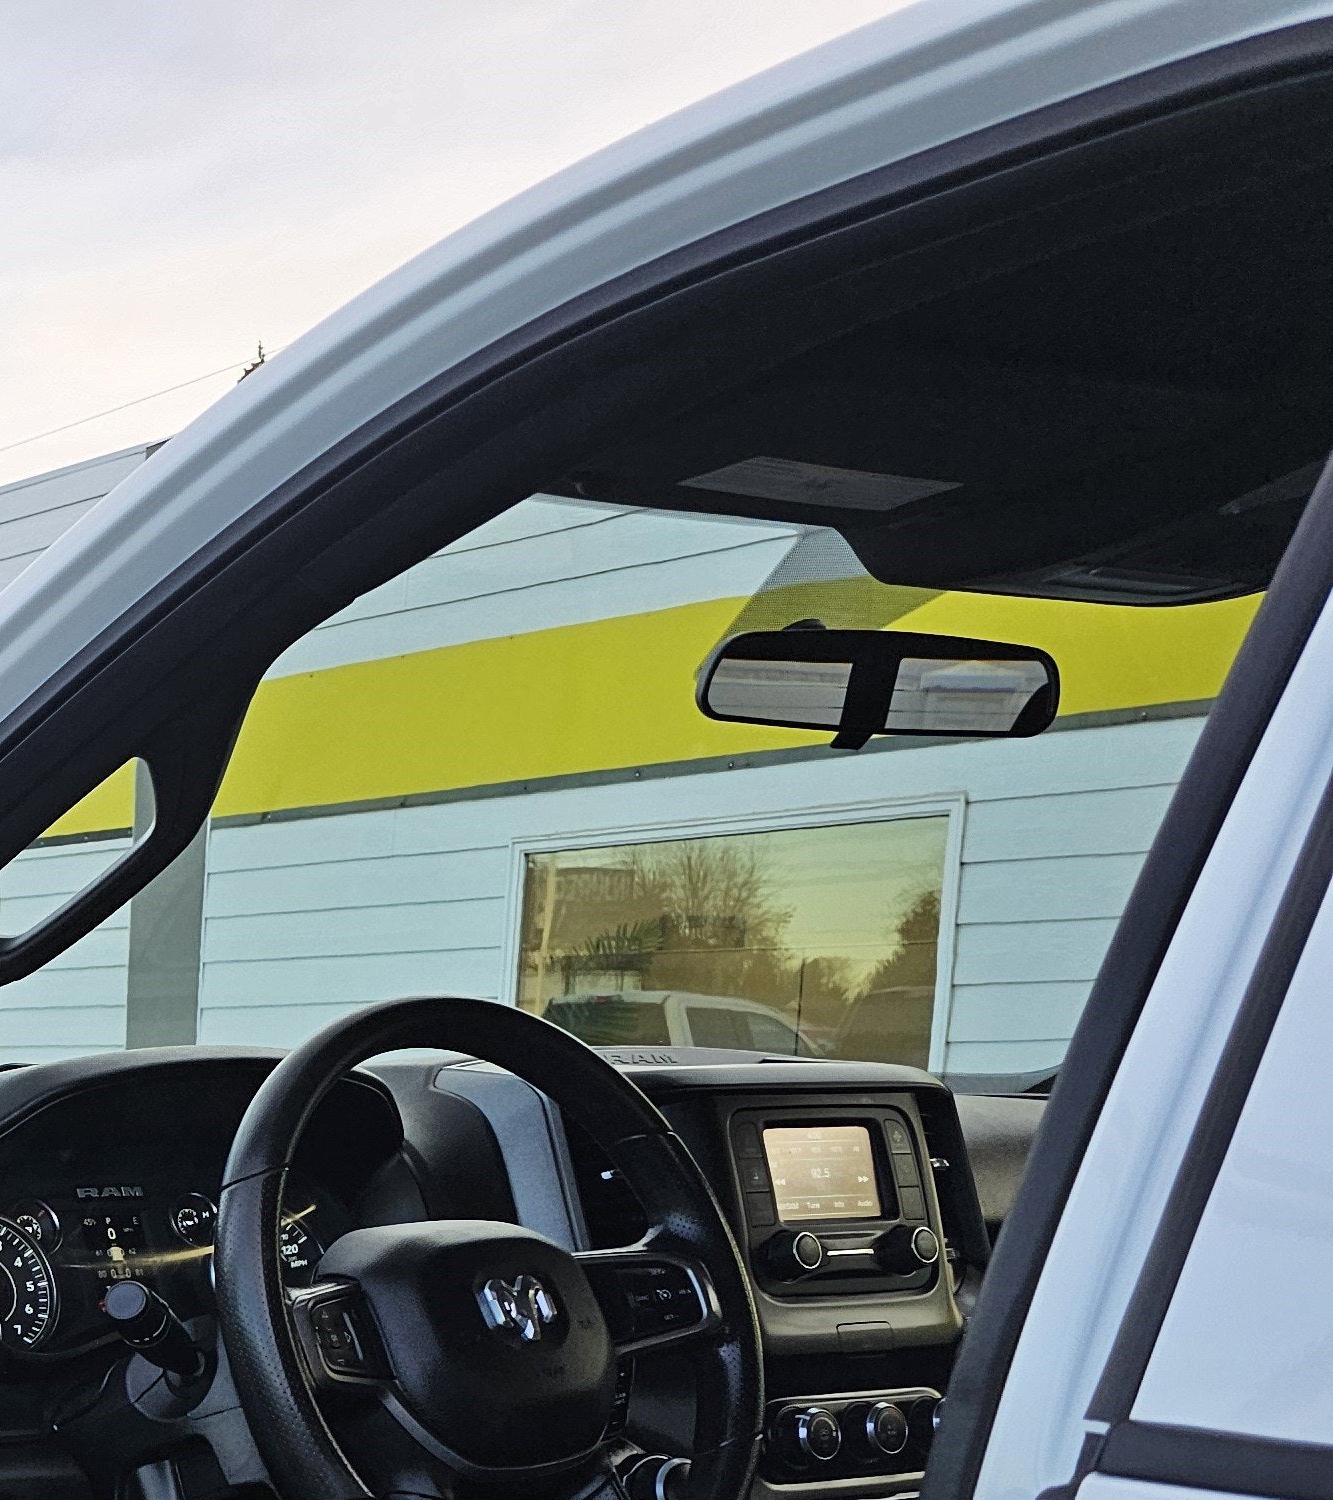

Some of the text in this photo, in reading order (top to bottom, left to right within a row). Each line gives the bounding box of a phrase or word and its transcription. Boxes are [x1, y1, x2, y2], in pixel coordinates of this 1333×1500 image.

[76, 1186, 144, 1198] RAM
[281, 1243, 299, 1255] 120
[13, 1256, 23, 1268] 4
[26, 1282, 35, 1293] 5
[24, 1304, 34, 1315] 6
[13, 1324, 23, 1335] 7
